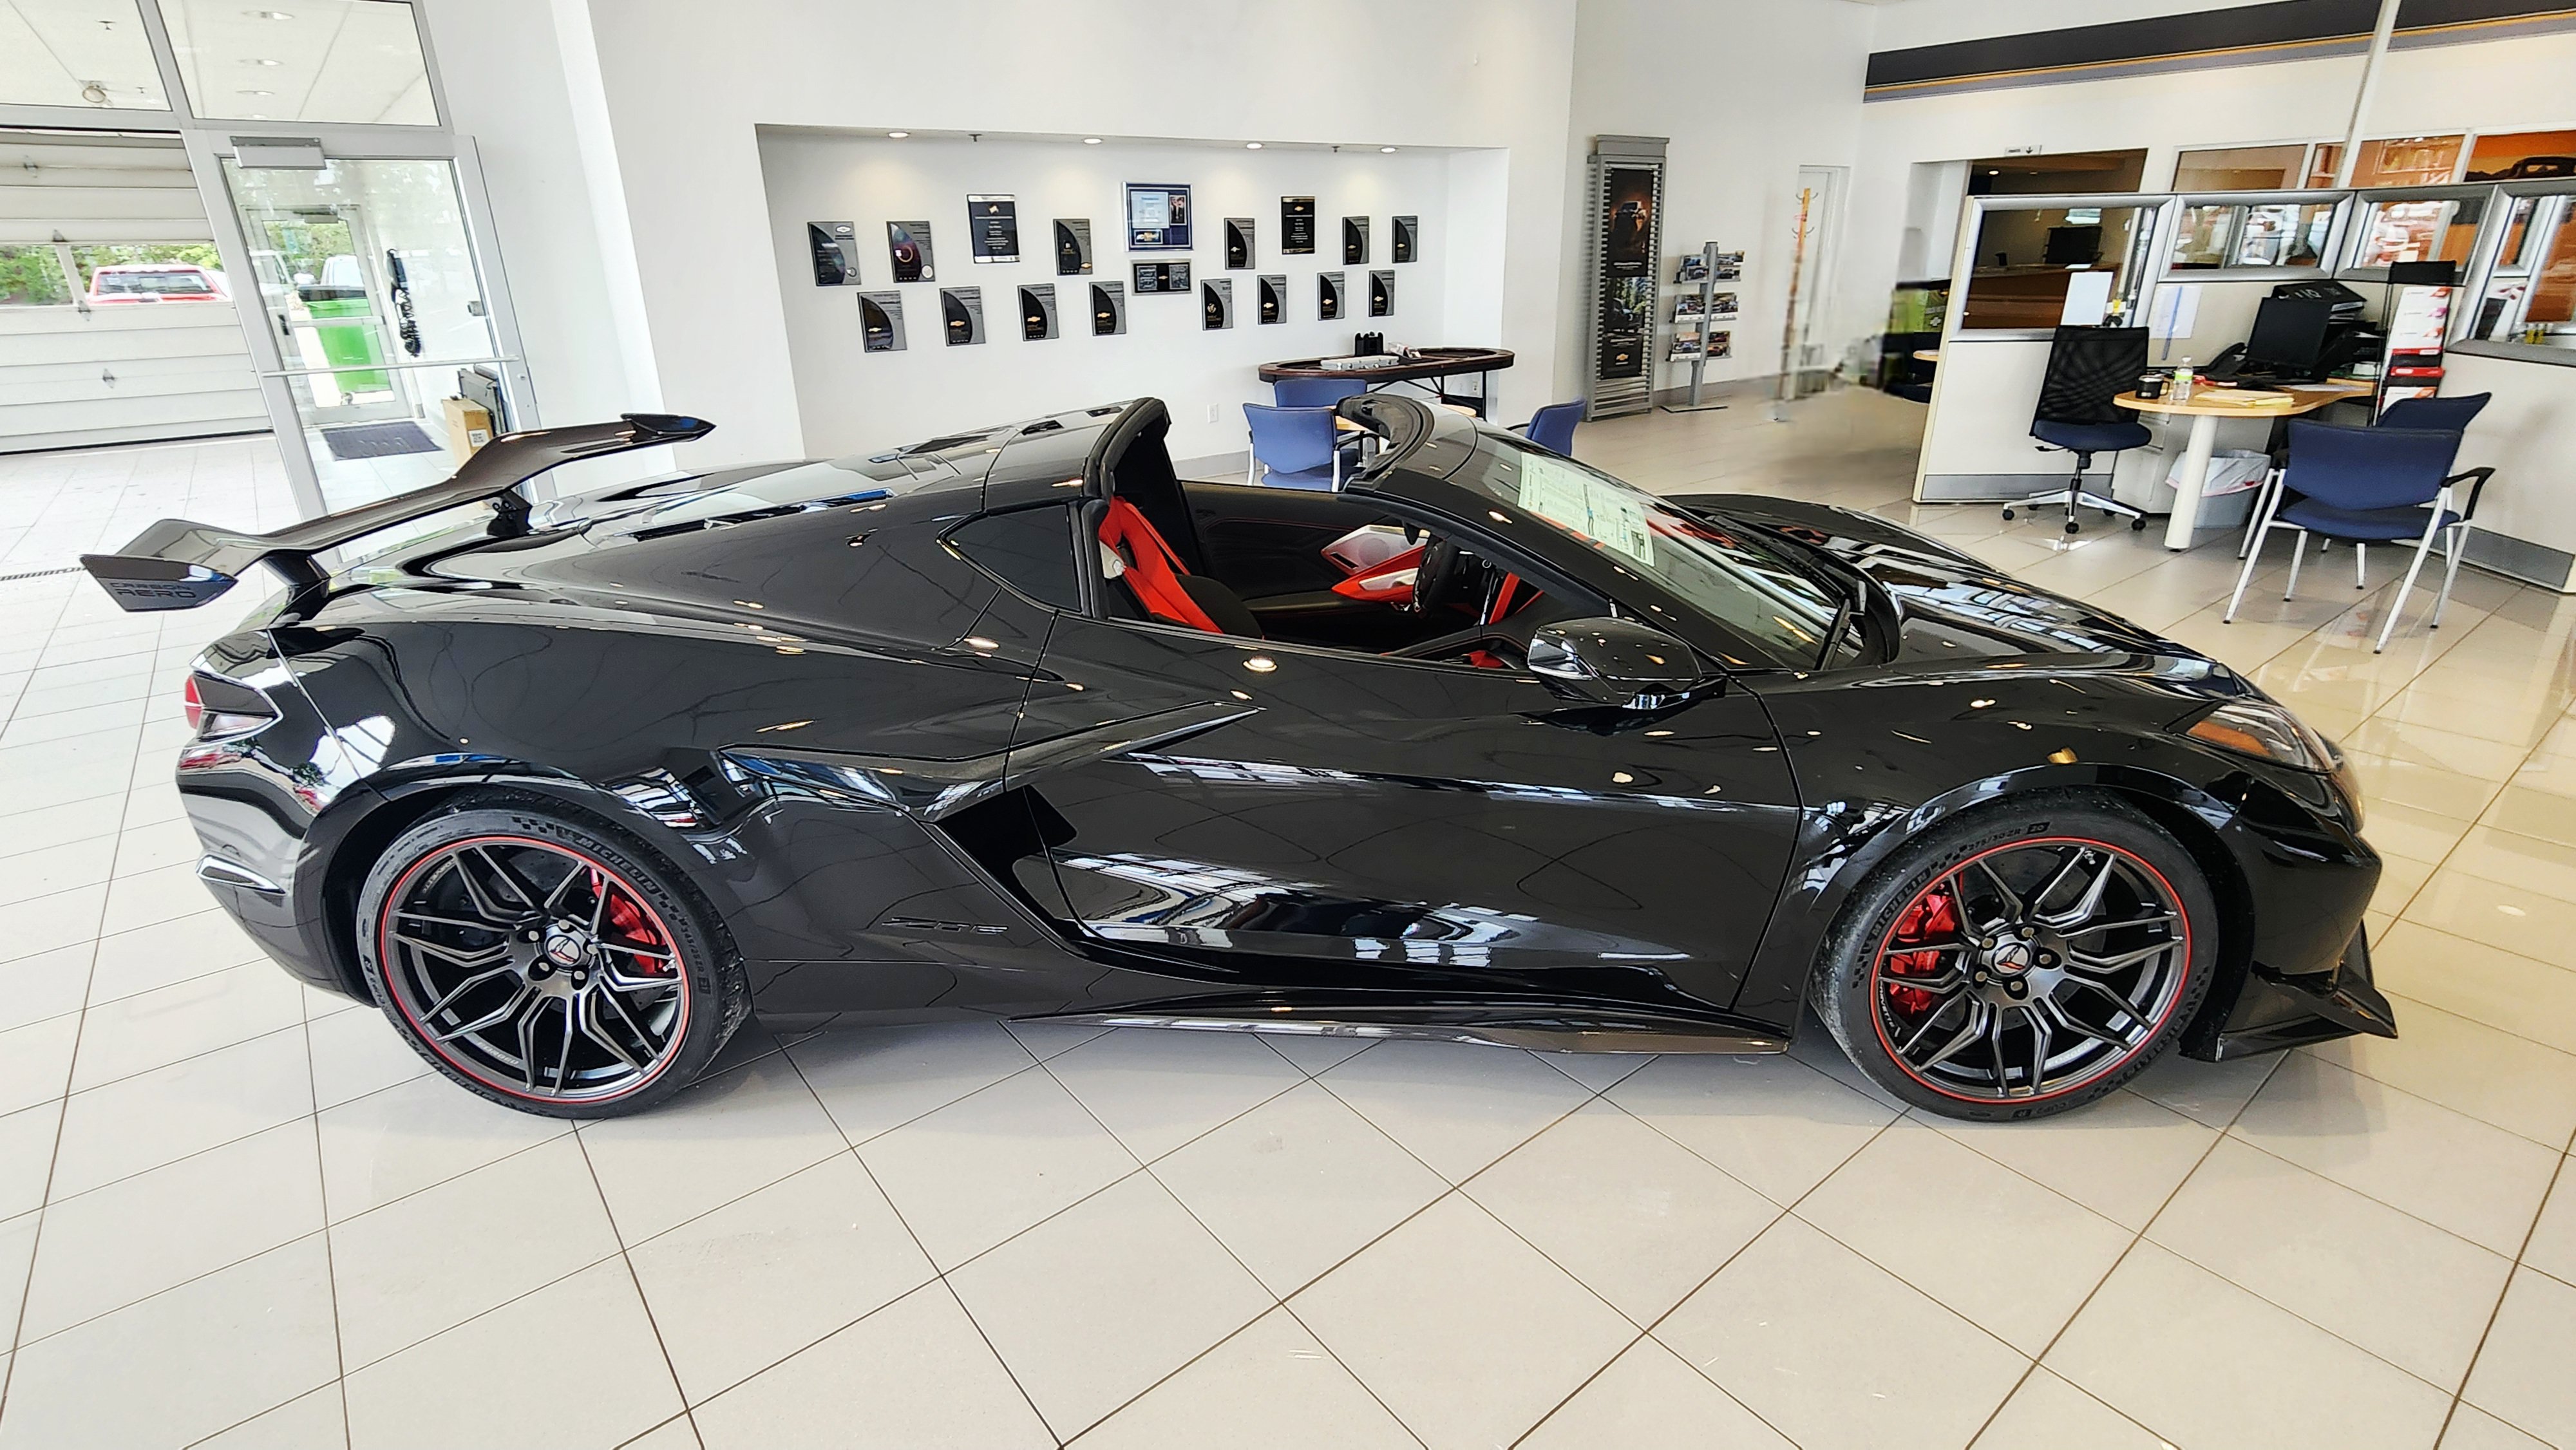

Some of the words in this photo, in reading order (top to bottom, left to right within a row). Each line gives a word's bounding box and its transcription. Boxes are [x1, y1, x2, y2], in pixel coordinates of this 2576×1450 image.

[110, 582, 191, 590] CARBON
[115, 588, 196, 598] AERO
[576, 836, 659, 896] MICHELIN
[1872, 870, 1931, 937] MICHELIN
[476, 1041, 519, 1065] FORGED
